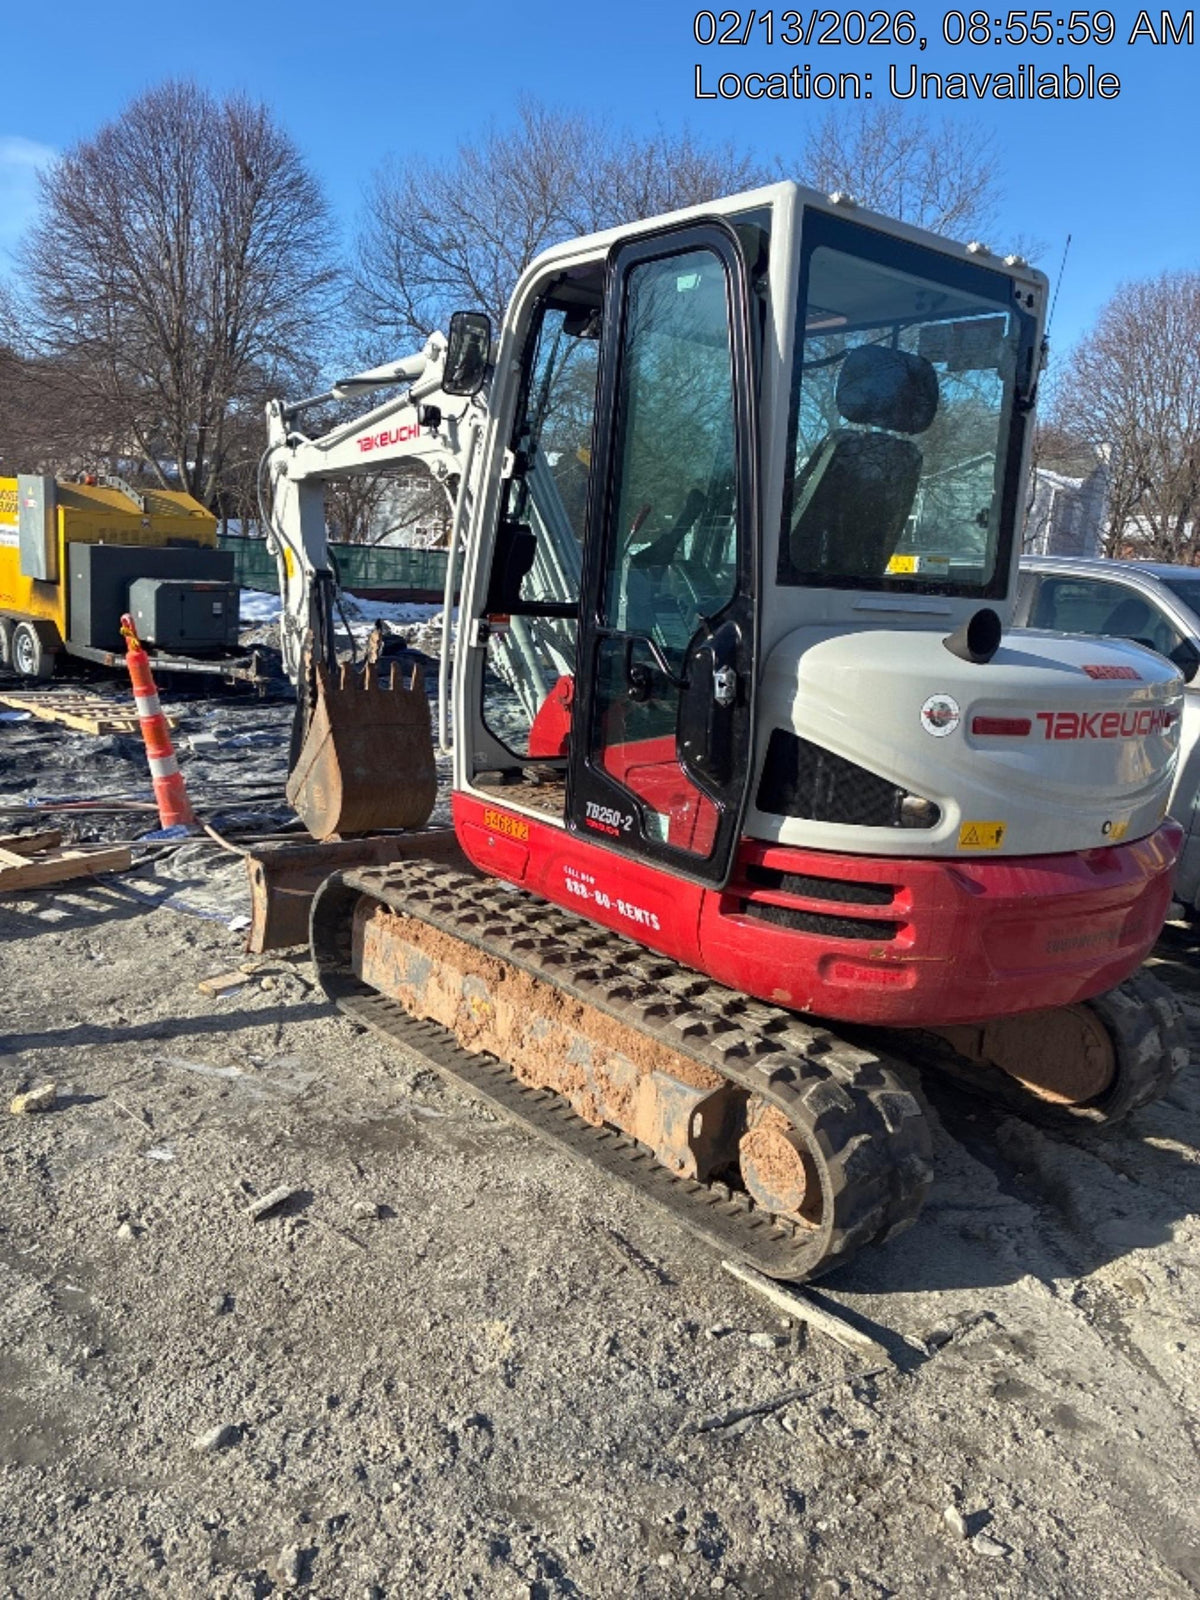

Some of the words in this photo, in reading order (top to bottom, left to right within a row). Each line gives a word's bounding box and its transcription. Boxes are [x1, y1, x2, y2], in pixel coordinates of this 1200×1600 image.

[357, 423, 421, 452] TAKEUCHI
[1036, 708, 1166, 741] TAKEUCHI
[585, 801, 634, 831] TB250-2
